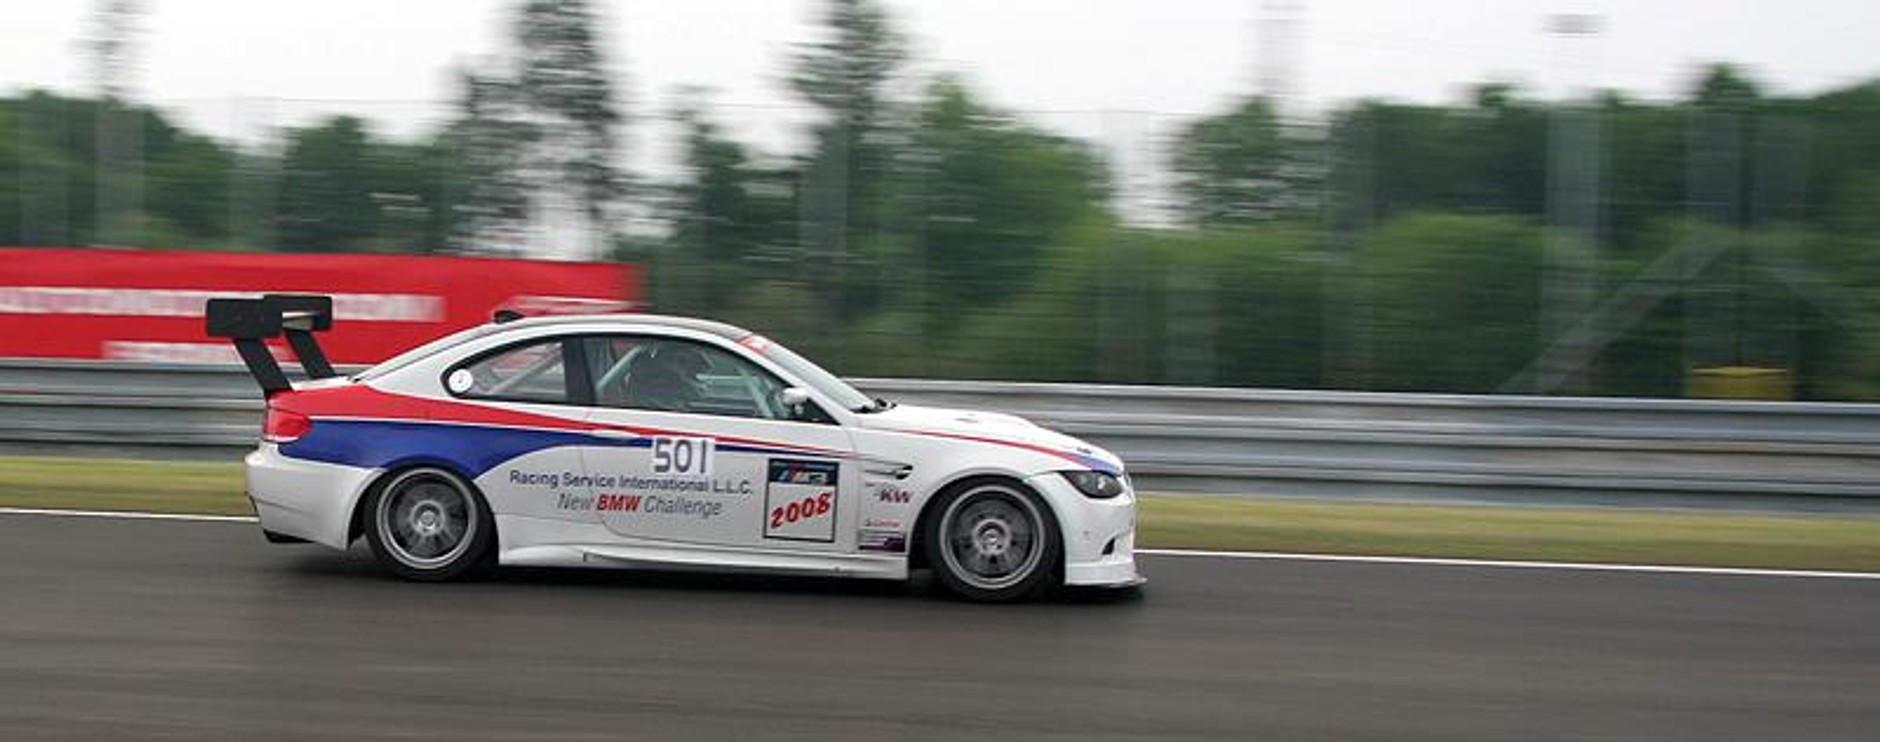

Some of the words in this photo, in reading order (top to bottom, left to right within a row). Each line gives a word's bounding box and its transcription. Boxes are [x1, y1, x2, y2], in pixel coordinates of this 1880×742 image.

[654, 439, 707, 474] 501
[510, 470, 558, 489] Racing
[562, 472, 616, 488] Service
[619, 473, 709, 492] International
[712, 479, 753, 495] L.L.C.
[557, 493, 593, 510] New
[596, 493, 641, 512] BMW
[643, 495, 723, 518] Challenge
[771, 491, 834, 529] 2008
